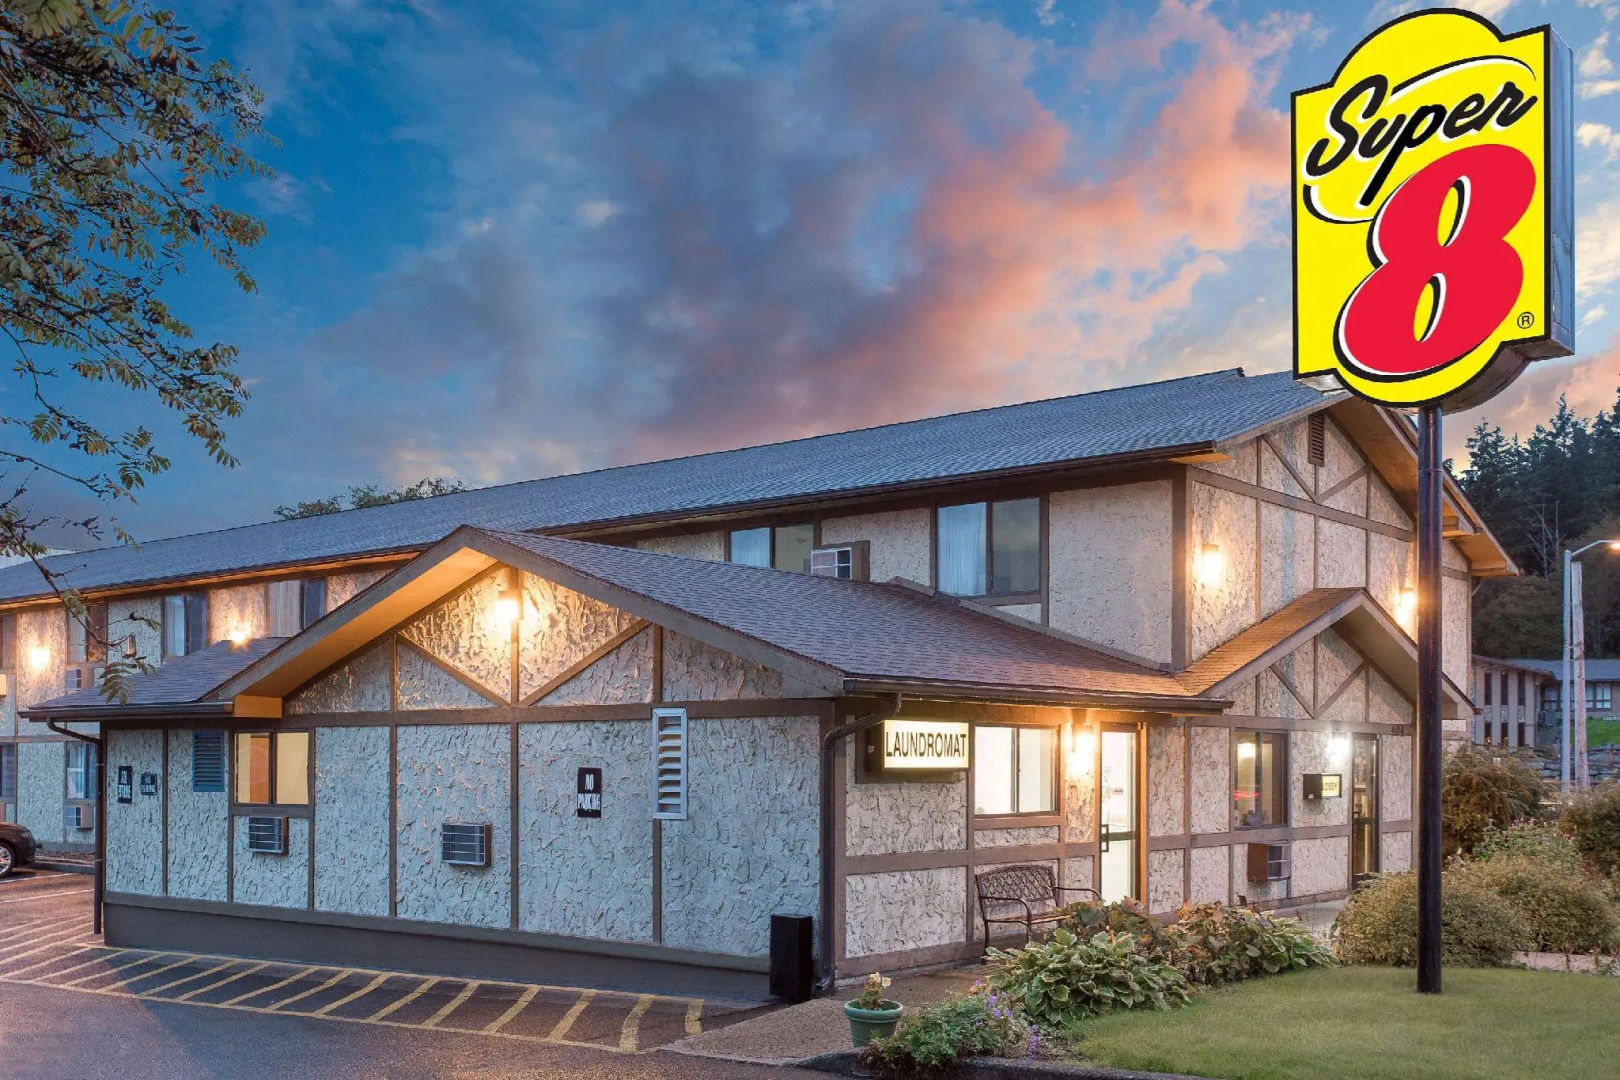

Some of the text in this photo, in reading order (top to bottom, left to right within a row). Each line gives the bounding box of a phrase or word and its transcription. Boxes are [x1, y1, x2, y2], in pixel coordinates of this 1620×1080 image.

[1304, 73, 1538, 207] Super
[1335, 143, 1537, 381] 8
[585, 773, 594, 791] NO
[885, 731, 967, 758] LAUNDROMAT
